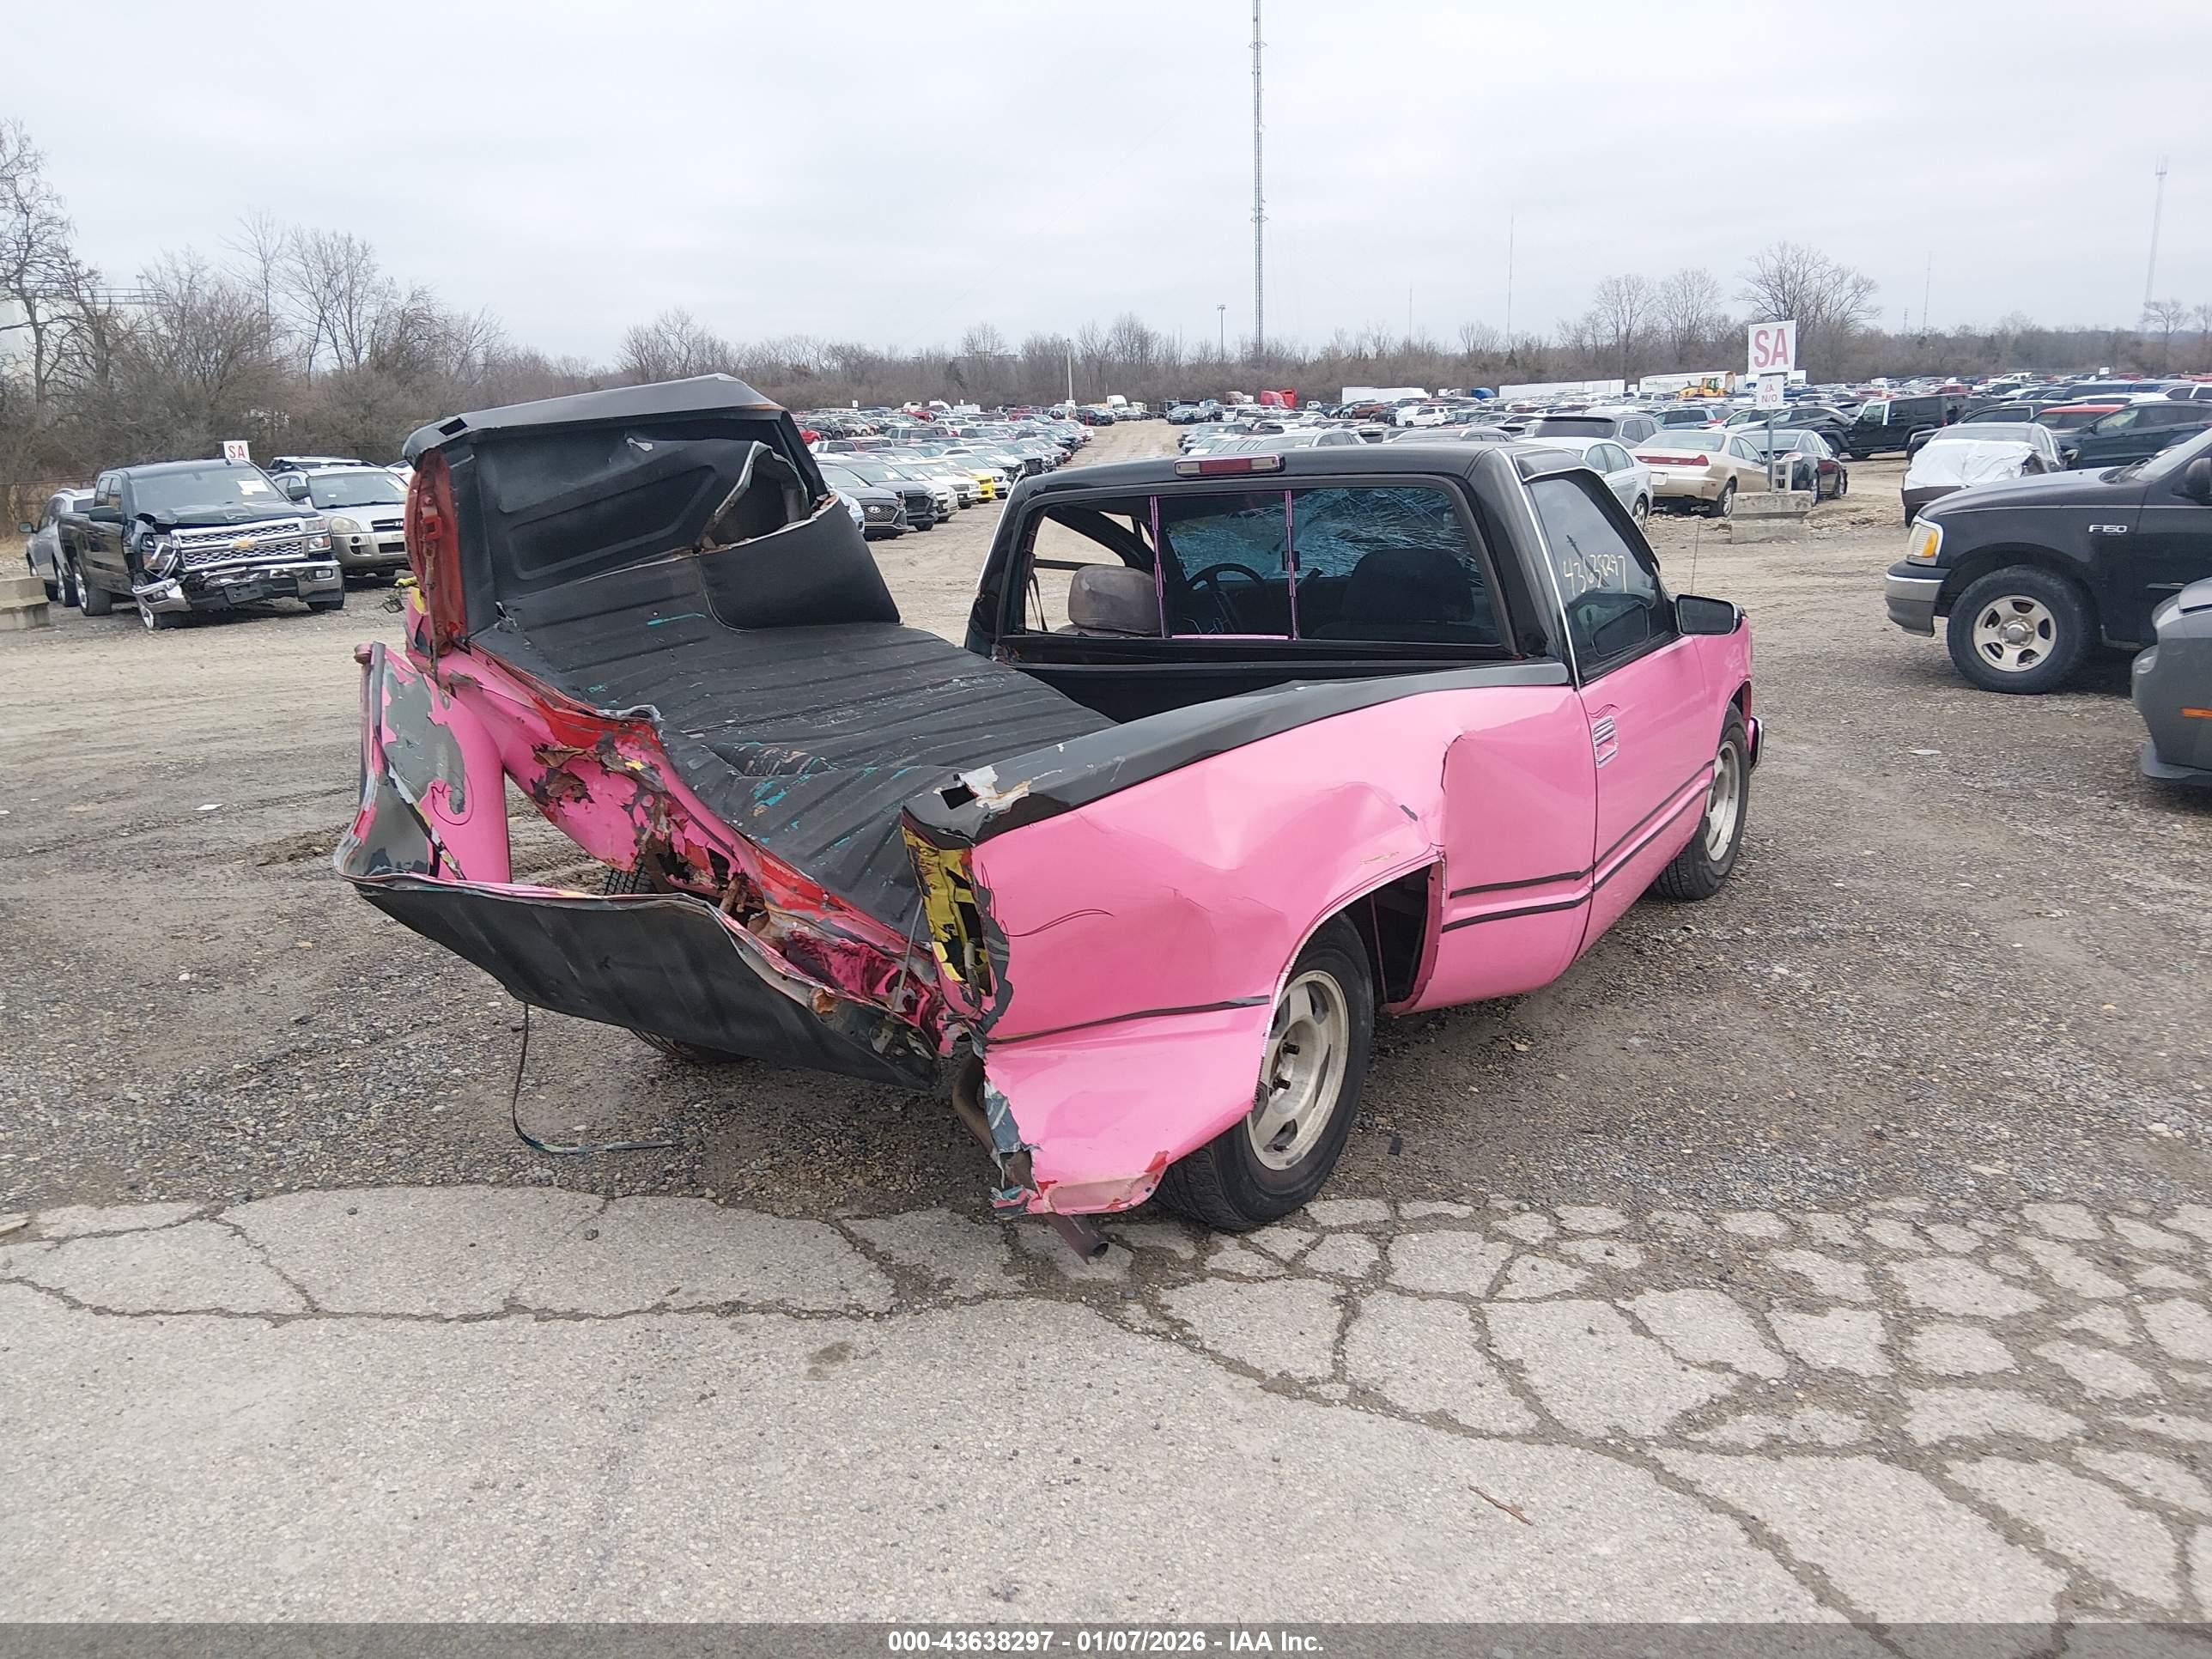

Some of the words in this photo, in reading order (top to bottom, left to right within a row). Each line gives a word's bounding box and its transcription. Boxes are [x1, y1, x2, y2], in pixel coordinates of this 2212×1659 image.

[1754, 329, 1789, 368] SA
[228, 445, 246, 459] SA
[1563, 554, 1627, 596] 43638297
